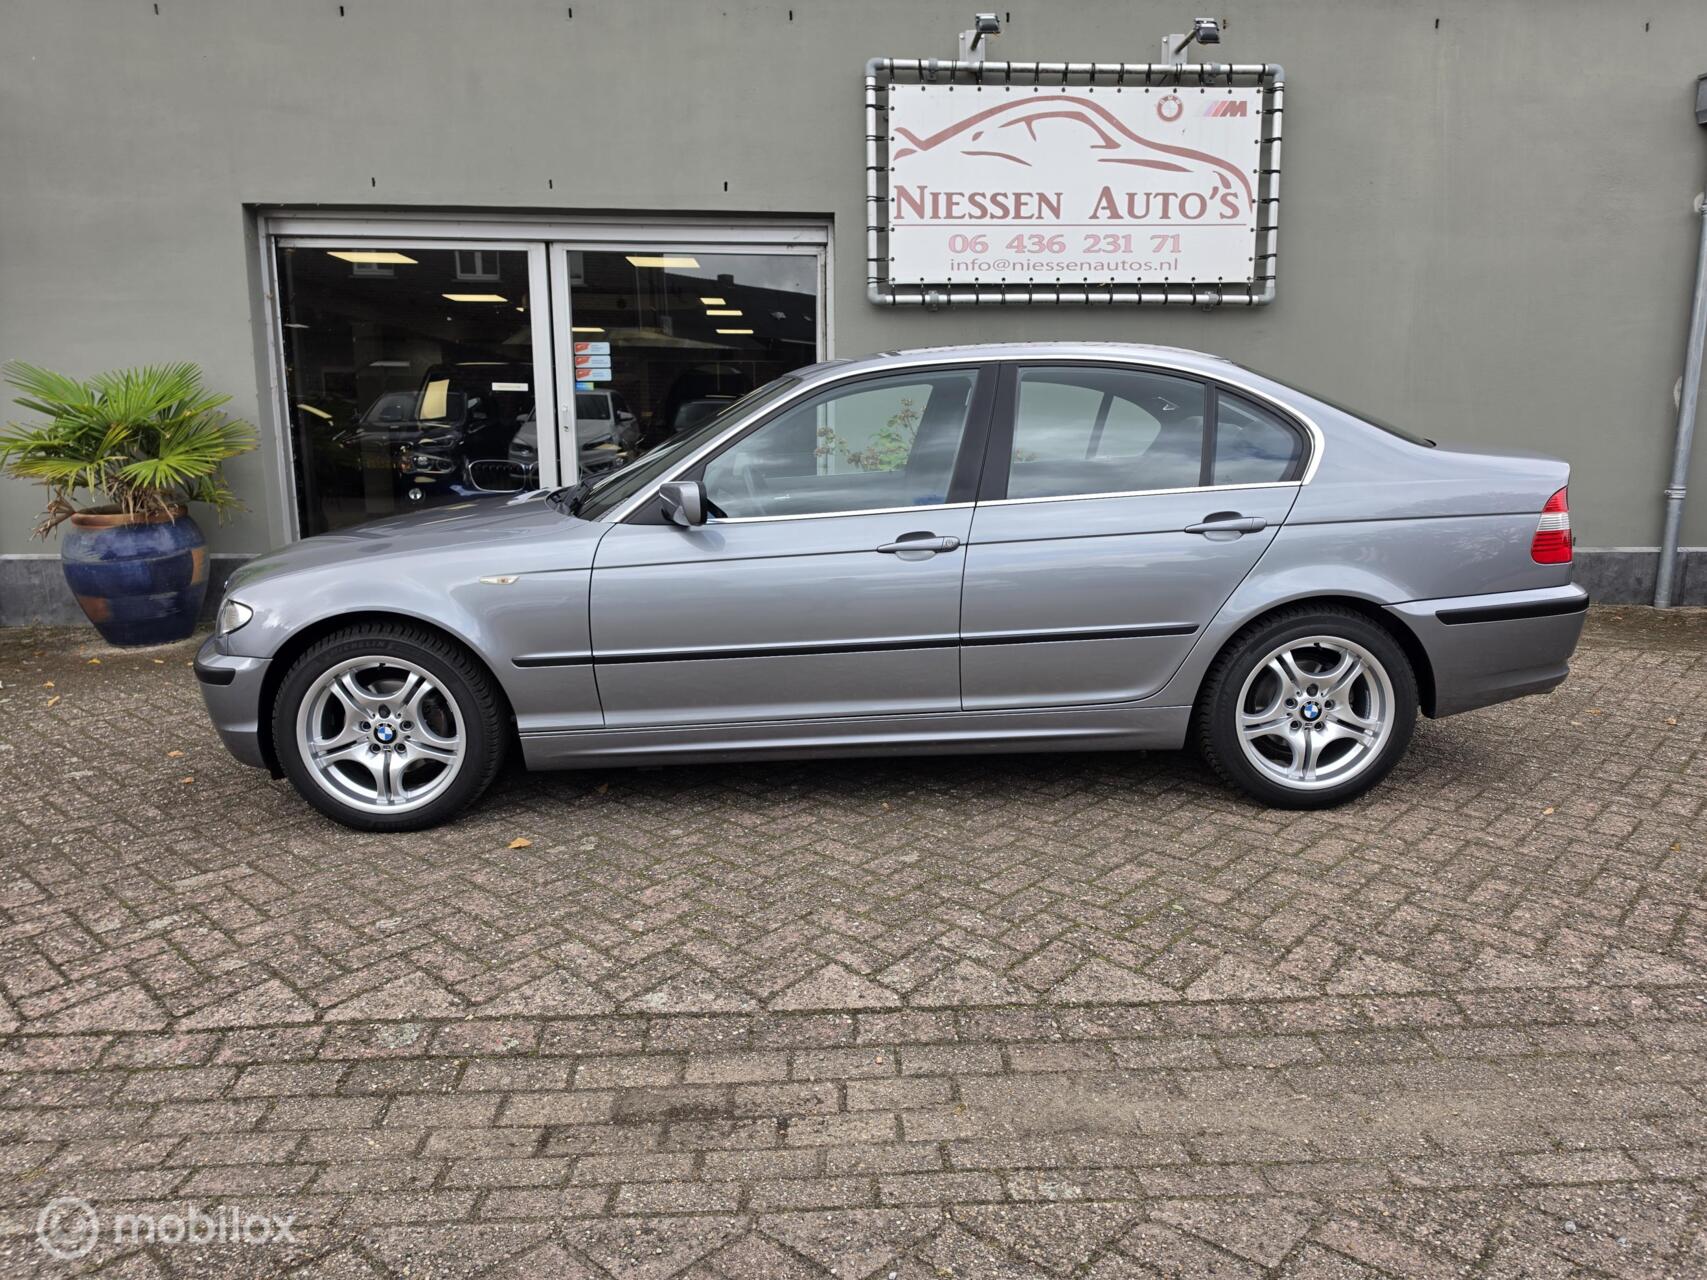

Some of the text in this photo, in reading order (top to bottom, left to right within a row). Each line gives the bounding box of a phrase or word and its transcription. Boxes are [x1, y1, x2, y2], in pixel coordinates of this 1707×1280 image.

[893, 185, 1241, 220] NIESSEN AUTO'S
[948, 233, 1182, 254] 06 436 231 71
[951, 257, 1178, 272] info@niessenautos.nl
